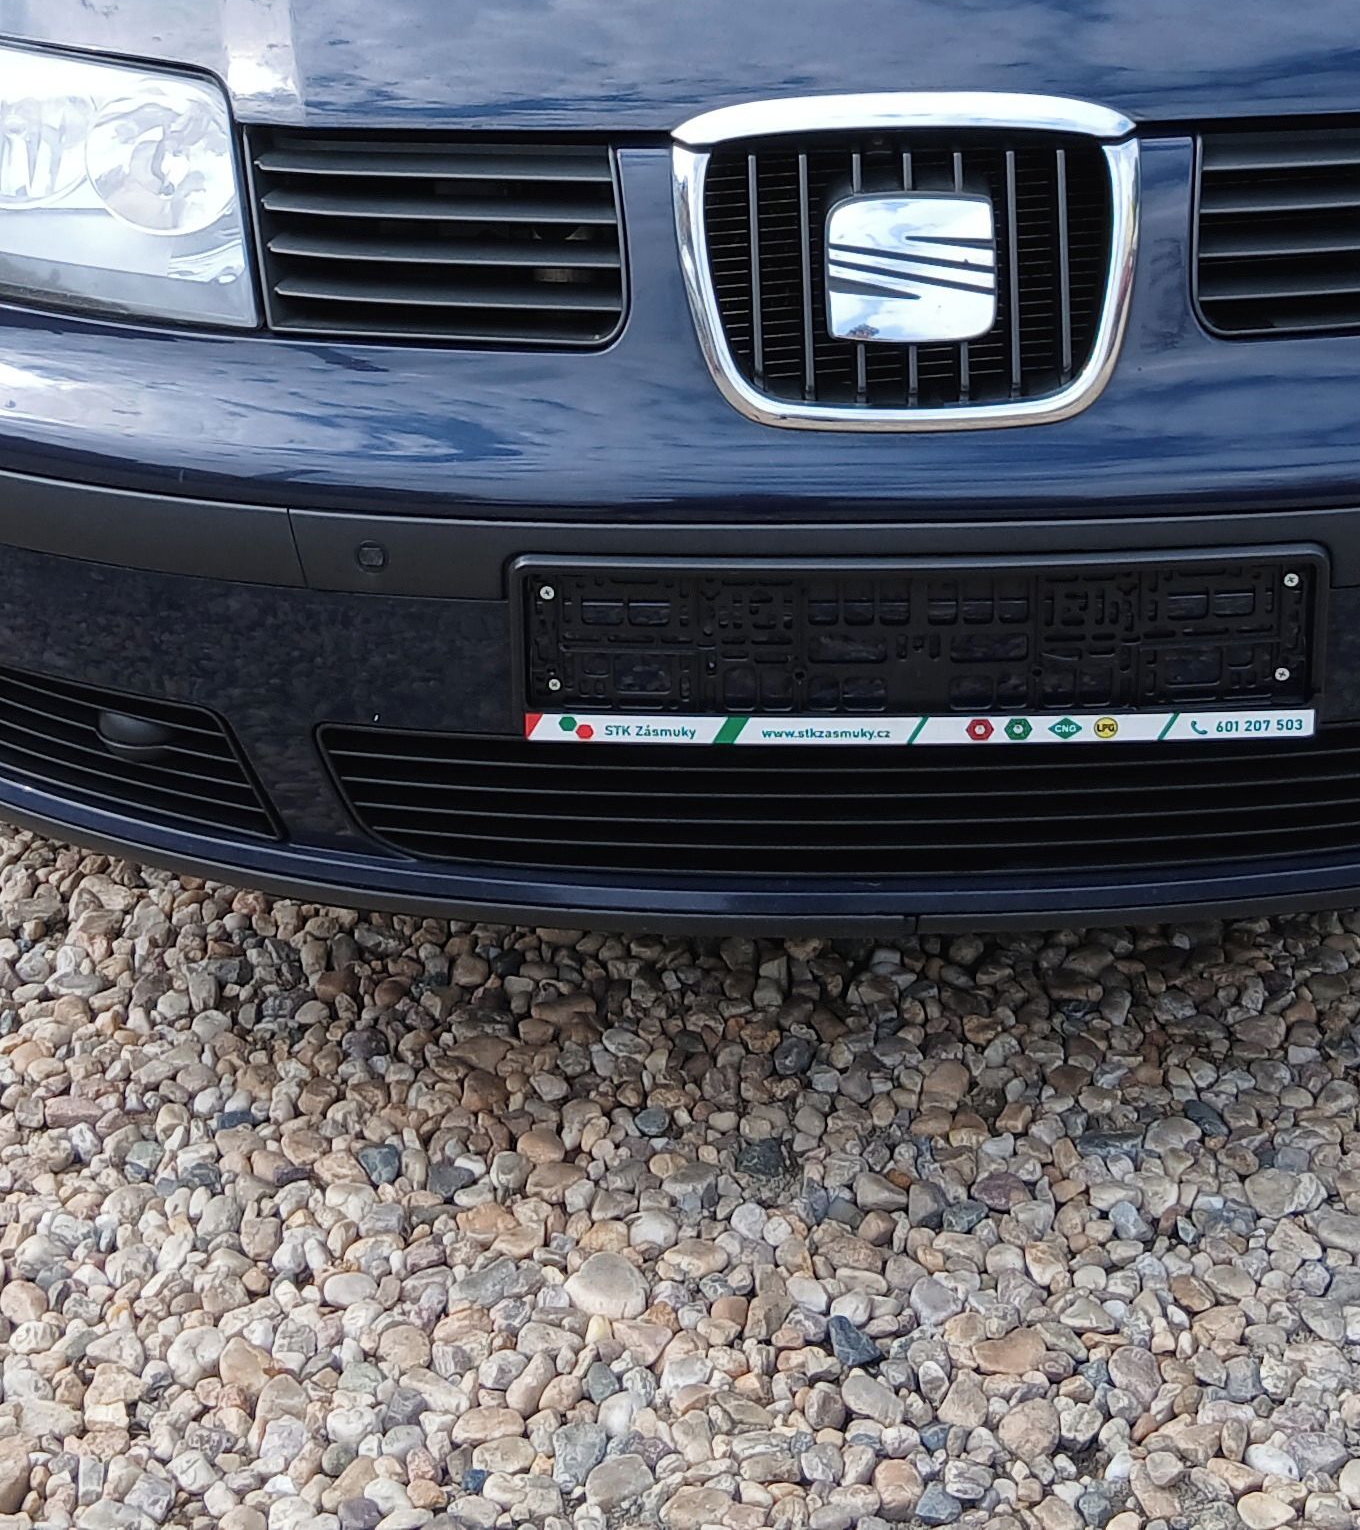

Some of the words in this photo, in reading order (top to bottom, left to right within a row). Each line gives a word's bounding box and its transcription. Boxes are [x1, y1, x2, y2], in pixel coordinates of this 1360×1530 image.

[604, 724, 632, 737] STK
[634, 724, 697, 741] Zásmuky
[1054, 723, 1077, 734] CNG
[1096, 722, 1115, 733] LPG
[1215, 720, 1240, 733] 601
[1243, 720, 1272, 733] 207
[1275, 718, 1303, 732] 503
[761, 727, 891, 741] www.stkzasmuky.cz
